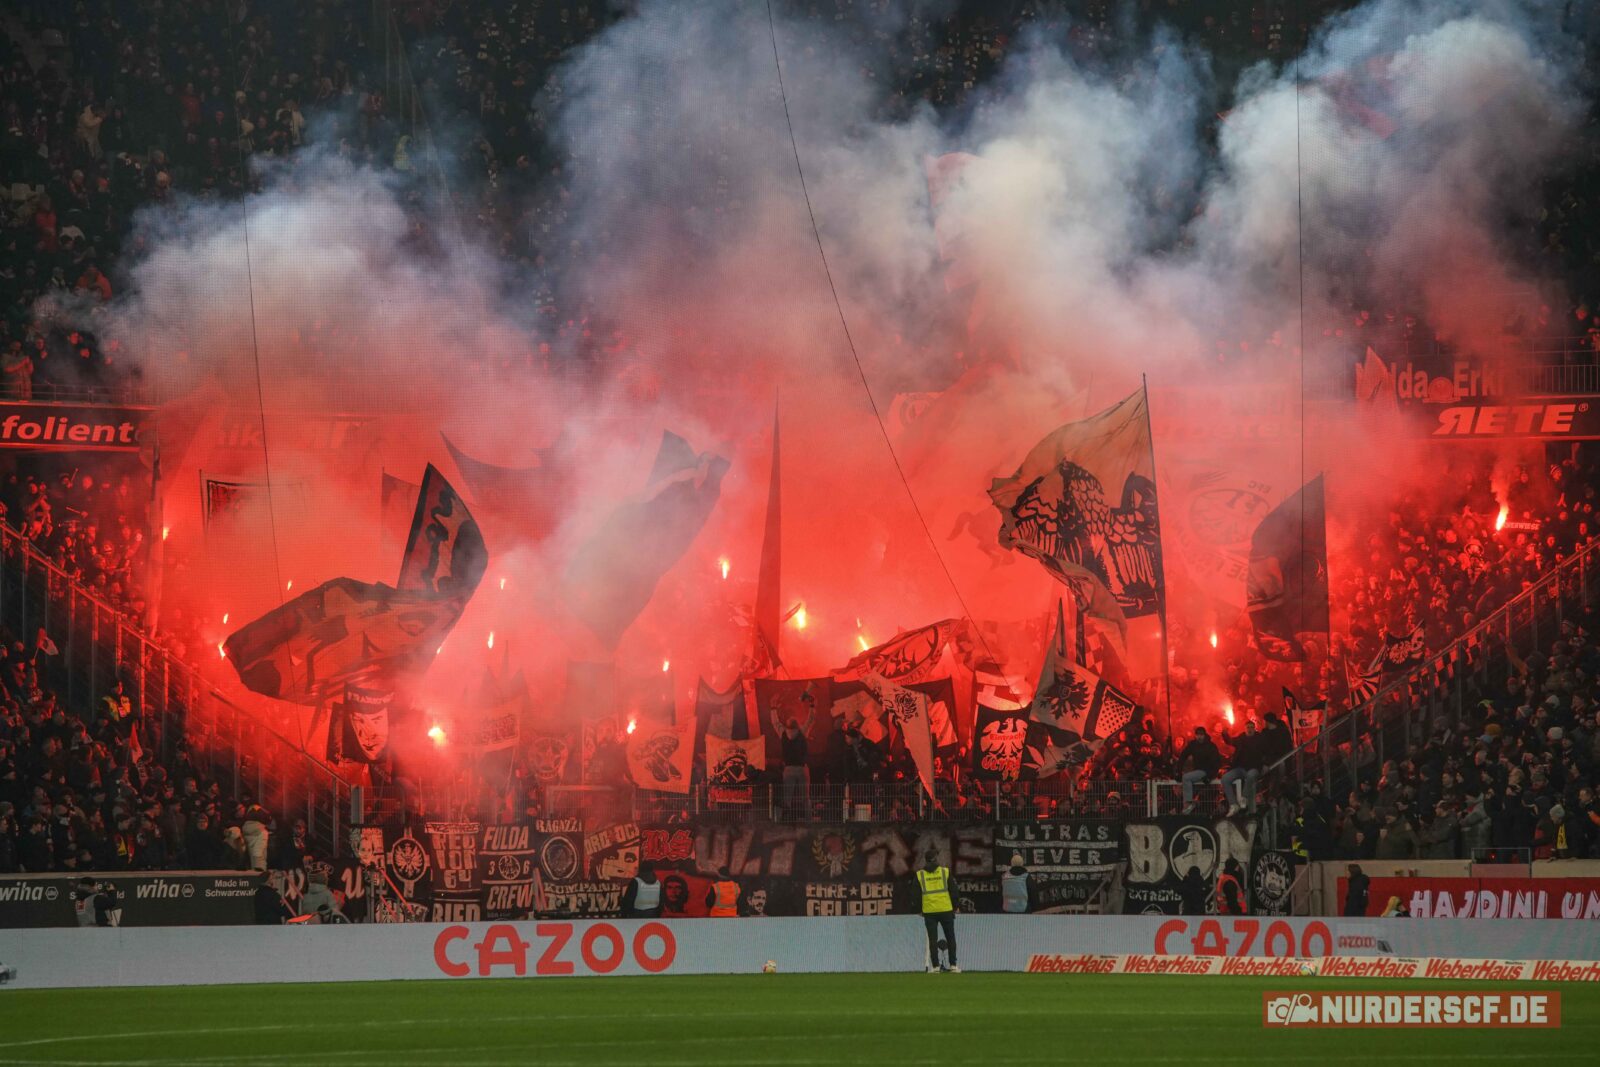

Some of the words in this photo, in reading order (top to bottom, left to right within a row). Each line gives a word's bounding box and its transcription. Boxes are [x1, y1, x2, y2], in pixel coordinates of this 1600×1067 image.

[2, 415, 134, 443] folient
[483, 826, 528, 850] FULDA
[1004, 824, 1109, 841] ULTRAS
[0, 881, 43, 902] wiha
[136, 879, 181, 899] wiha
[214, 880, 237, 888] Made
[239, 879, 250, 888] im
[860, 882, 894, 899] DER
[486, 885, 535, 911] CREW
[1154, 919, 1333, 957] CAZOO
[434, 922, 677, 976] CAZOO
[1029, 955, 1116, 973] WeberHaus
[1123, 955, 1212, 974] WeberHaus
[1220, 957, 1303, 975] WeberHau
[1319, 957, 1417, 977] WeberHaus
[1424, 959, 1523, 980] WeberHaus
